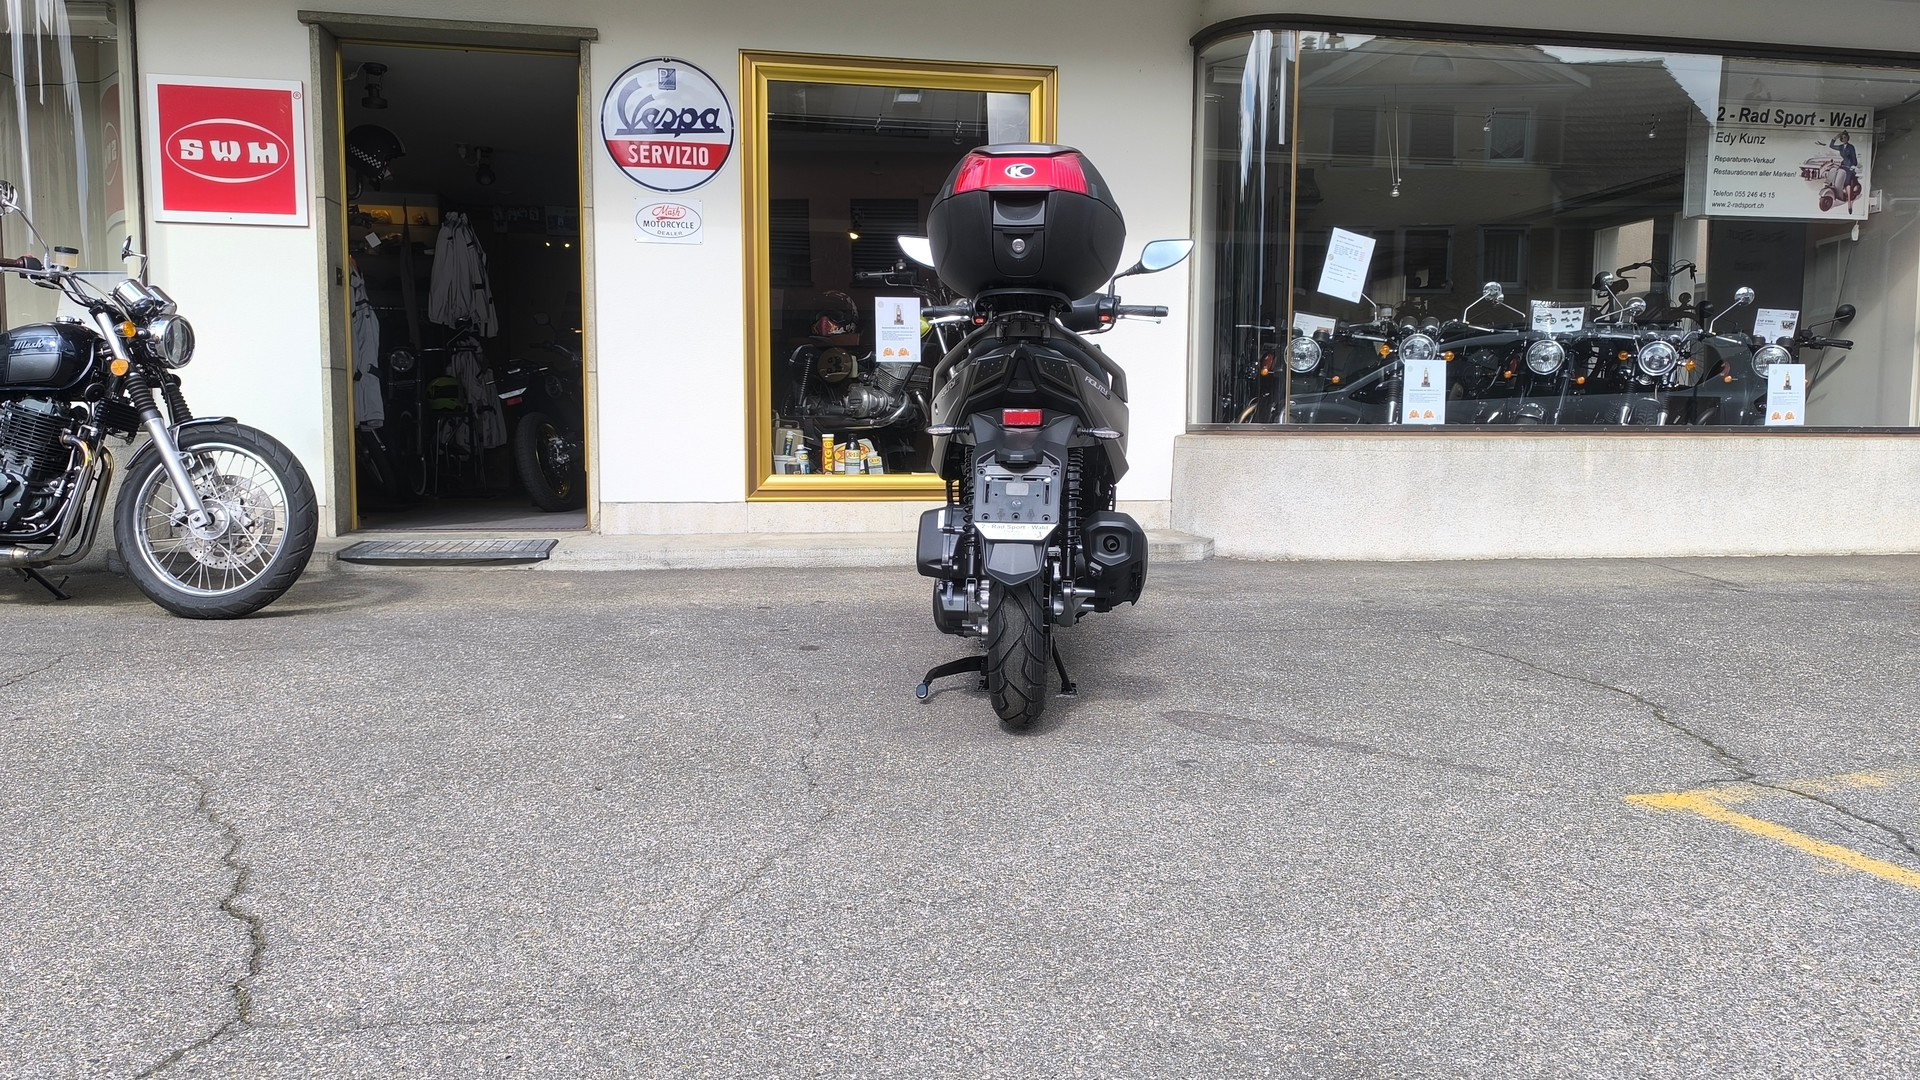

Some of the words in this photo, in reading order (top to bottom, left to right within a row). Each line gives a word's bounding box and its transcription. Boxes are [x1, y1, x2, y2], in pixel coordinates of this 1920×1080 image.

[614, 77, 725, 138] Vespa
[1716, 106, 1726, 122] 2
[1739, 108, 1771, 124] Rad
[1774, 109, 1817, 129] Sport
[1830, 112, 1868, 129] Wald
[1715, 131, 1737, 146] Edy
[1739, 132, 1767, 145] Kunz
[178, 139, 280, 166] SWM
[627, 144, 710, 166] SERVIZIO
[1713, 155, 1776, 165] Reparaturen-Verkauf
[1712, 168, 1758, 177] Restaurationen
[1758, 169, 1772, 177] aller
[1773, 170, 1797, 178] Marken!
[1712, 189, 1734, 198] Telefon
[1711, 201, 1765, 210] www.2-radsport.ch
[652, 205, 686, 220] Mash
[642, 219, 695, 230] MOTORCYCLE
[10, 339, 44, 350] Mash
